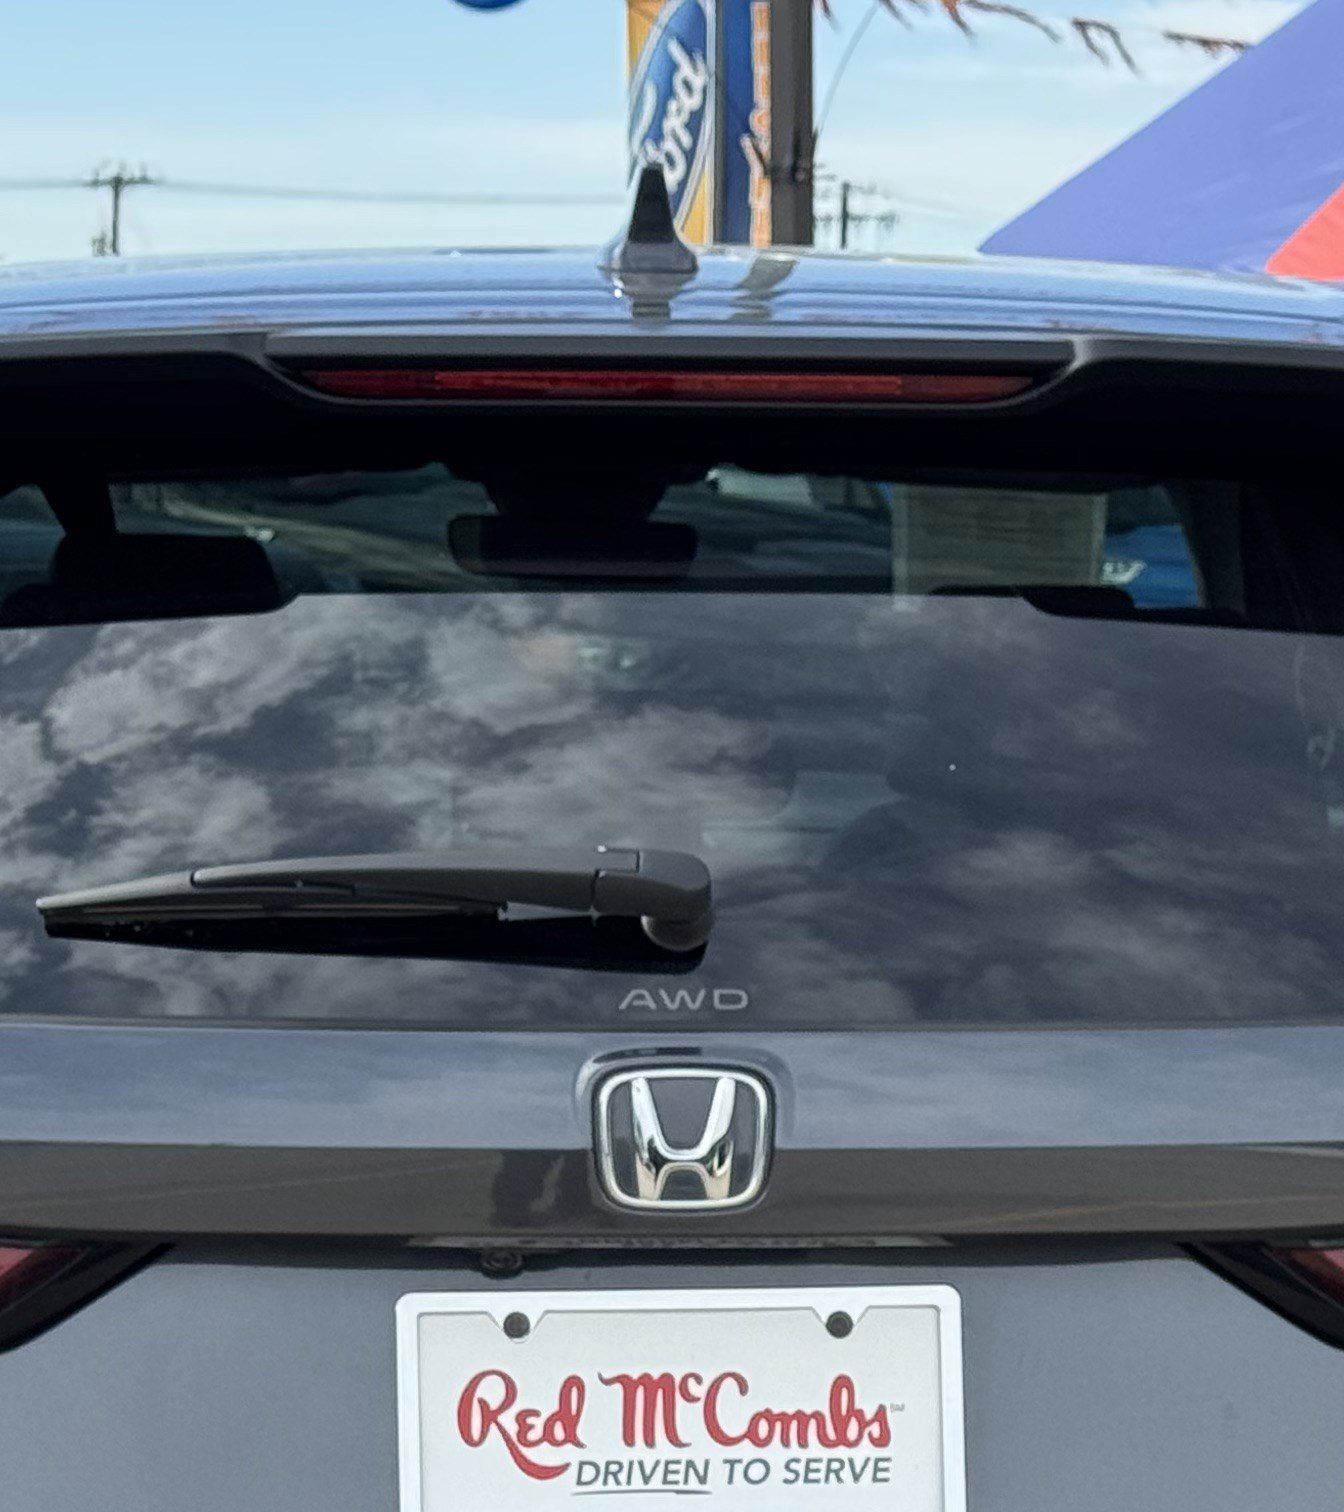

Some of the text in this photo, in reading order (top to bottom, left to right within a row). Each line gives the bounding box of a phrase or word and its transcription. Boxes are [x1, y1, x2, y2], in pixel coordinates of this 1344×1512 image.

[618, 988, 749, 1011] AWD
[457, 1369, 587, 1480] Red
[598, 1371, 891, 1449] McCombs
[575, 1456, 892, 1486] DRIVEN TO SERVE
